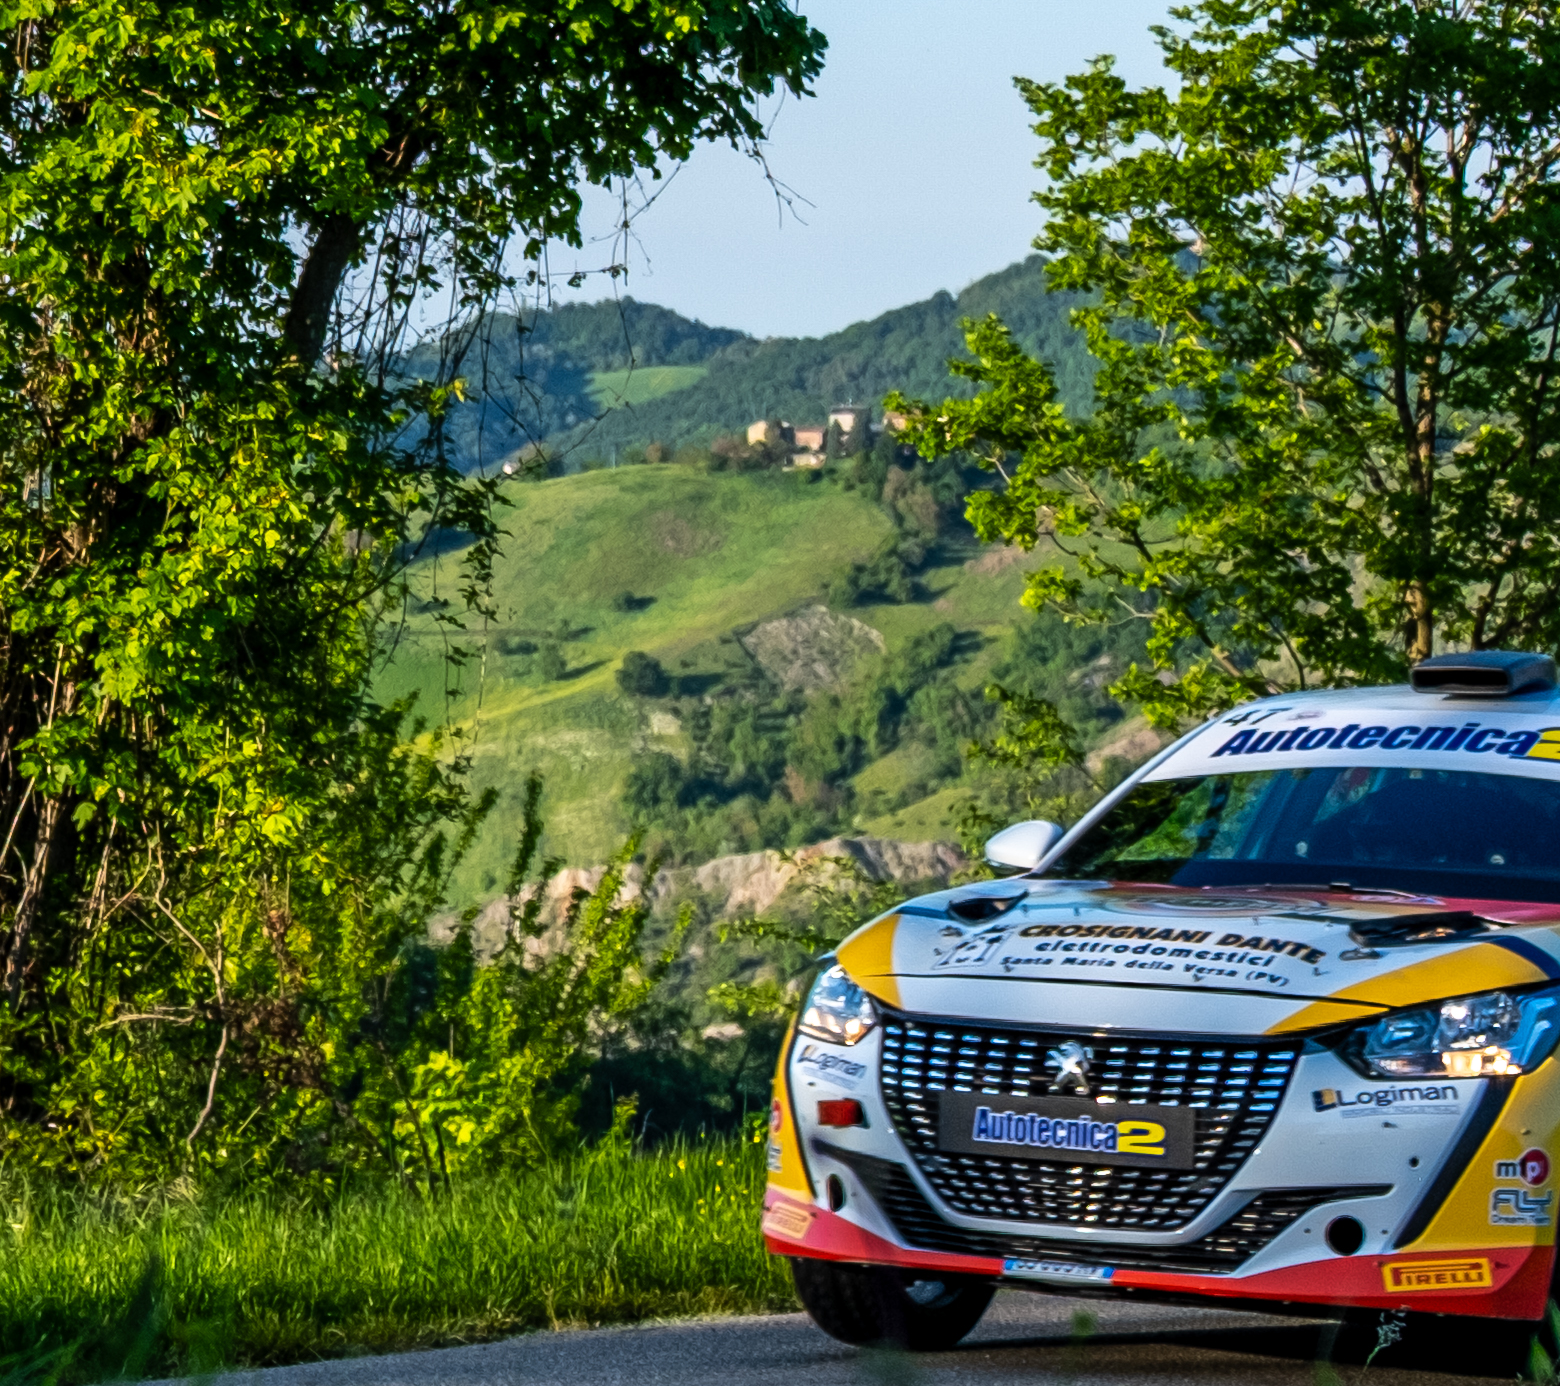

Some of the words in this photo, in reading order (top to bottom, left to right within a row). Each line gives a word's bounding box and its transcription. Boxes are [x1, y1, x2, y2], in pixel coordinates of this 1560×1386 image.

[1019, 924, 1214, 944] CROSIGNANI
[1215, 933, 1327, 964] DANTE
[1035, 940, 1277, 967] elettrodomestici
[1001, 957, 1053, 965] Santa
[1060, 957, 1116, 967] Maria
[1125, 959, 1174, 971] della
[1184, 963, 1238, 977] Versa
[1245, 970, 1289, 987] (PV)
[1336, 1085, 1459, 1107] Logiman
[1391, 1263, 1484, 1287] PIRELLI
